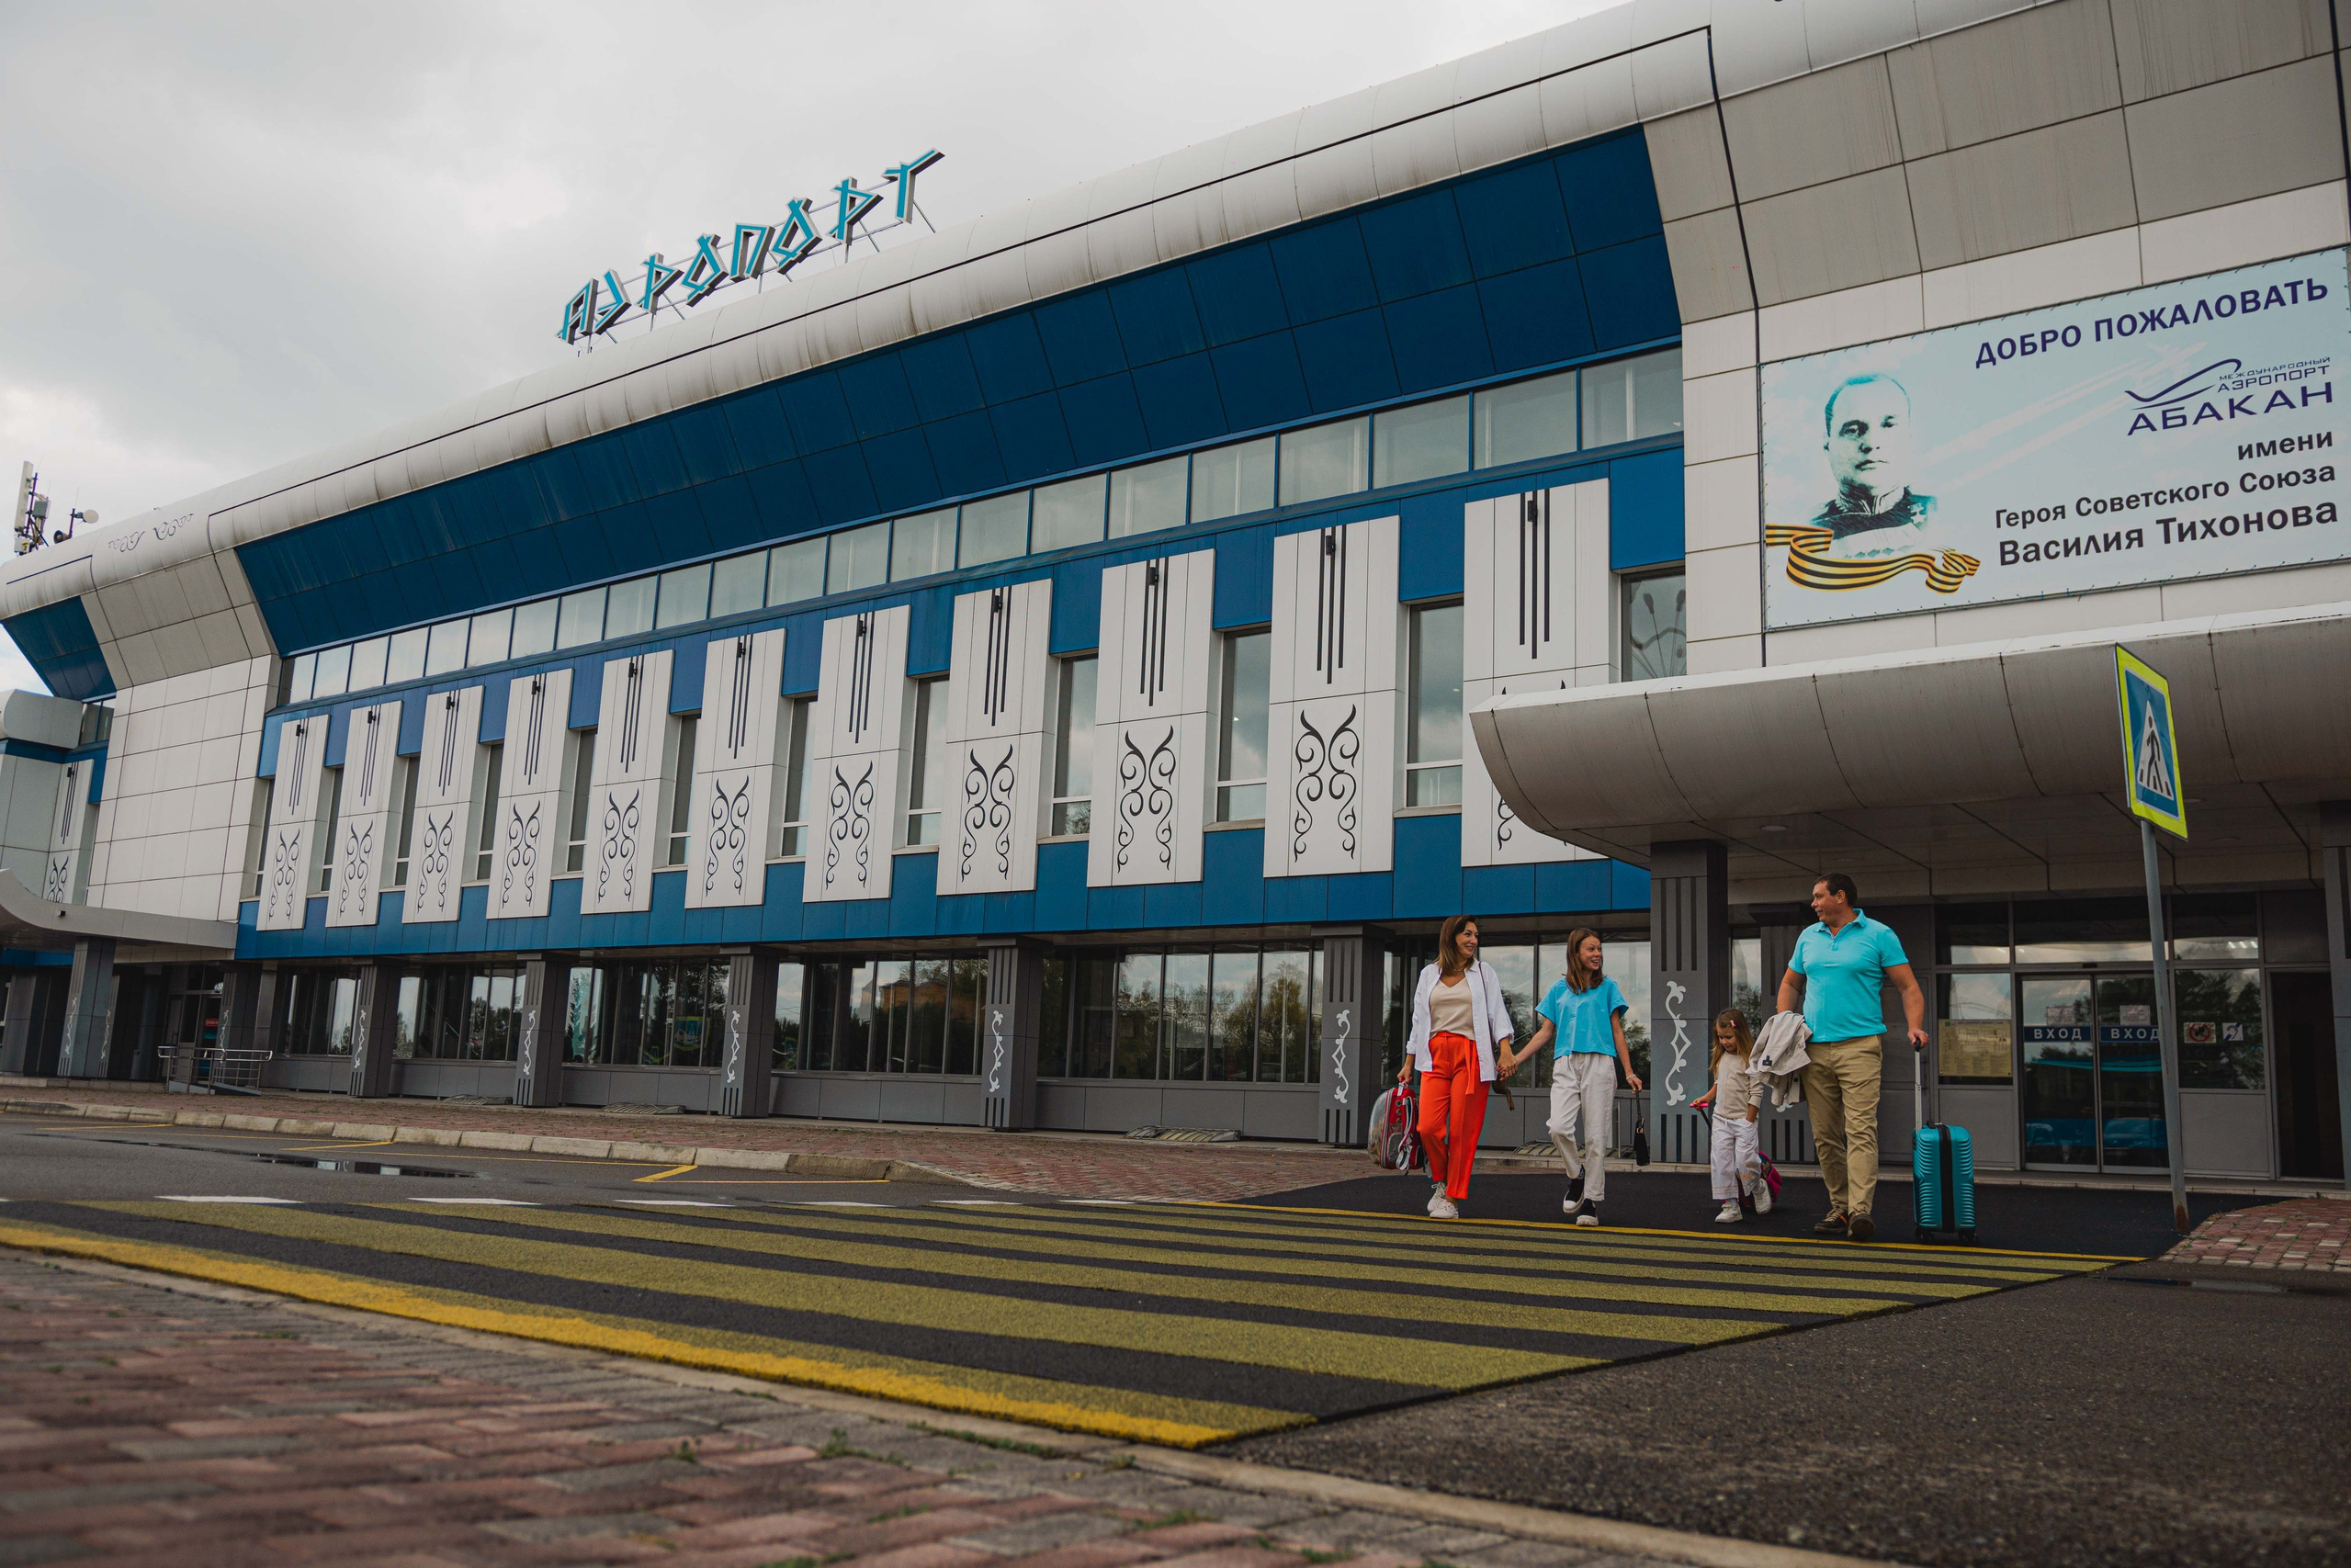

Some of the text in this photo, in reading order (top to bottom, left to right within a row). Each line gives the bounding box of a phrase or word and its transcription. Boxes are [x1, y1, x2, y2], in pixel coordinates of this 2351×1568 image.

[1975, 277, 2328, 368] ДОБРО ПОЖАЛОВАТЬ
[2217, 365, 2331, 393] АЭРОПОРТ
[2219, 356, 2331, 381] МЕЖДУНАРОДНЫЙ
[2127, 381, 2334, 436] АБАКАН
[2237, 431, 2334, 460] имени
[1995, 465, 2336, 529] Героя Советского Союза
[1999, 501, 2338, 566] Василия Тихонова
[2033, 1028, 2083, 1041] ВХОД
[2110, 1028, 2160, 1041] ВХОД
